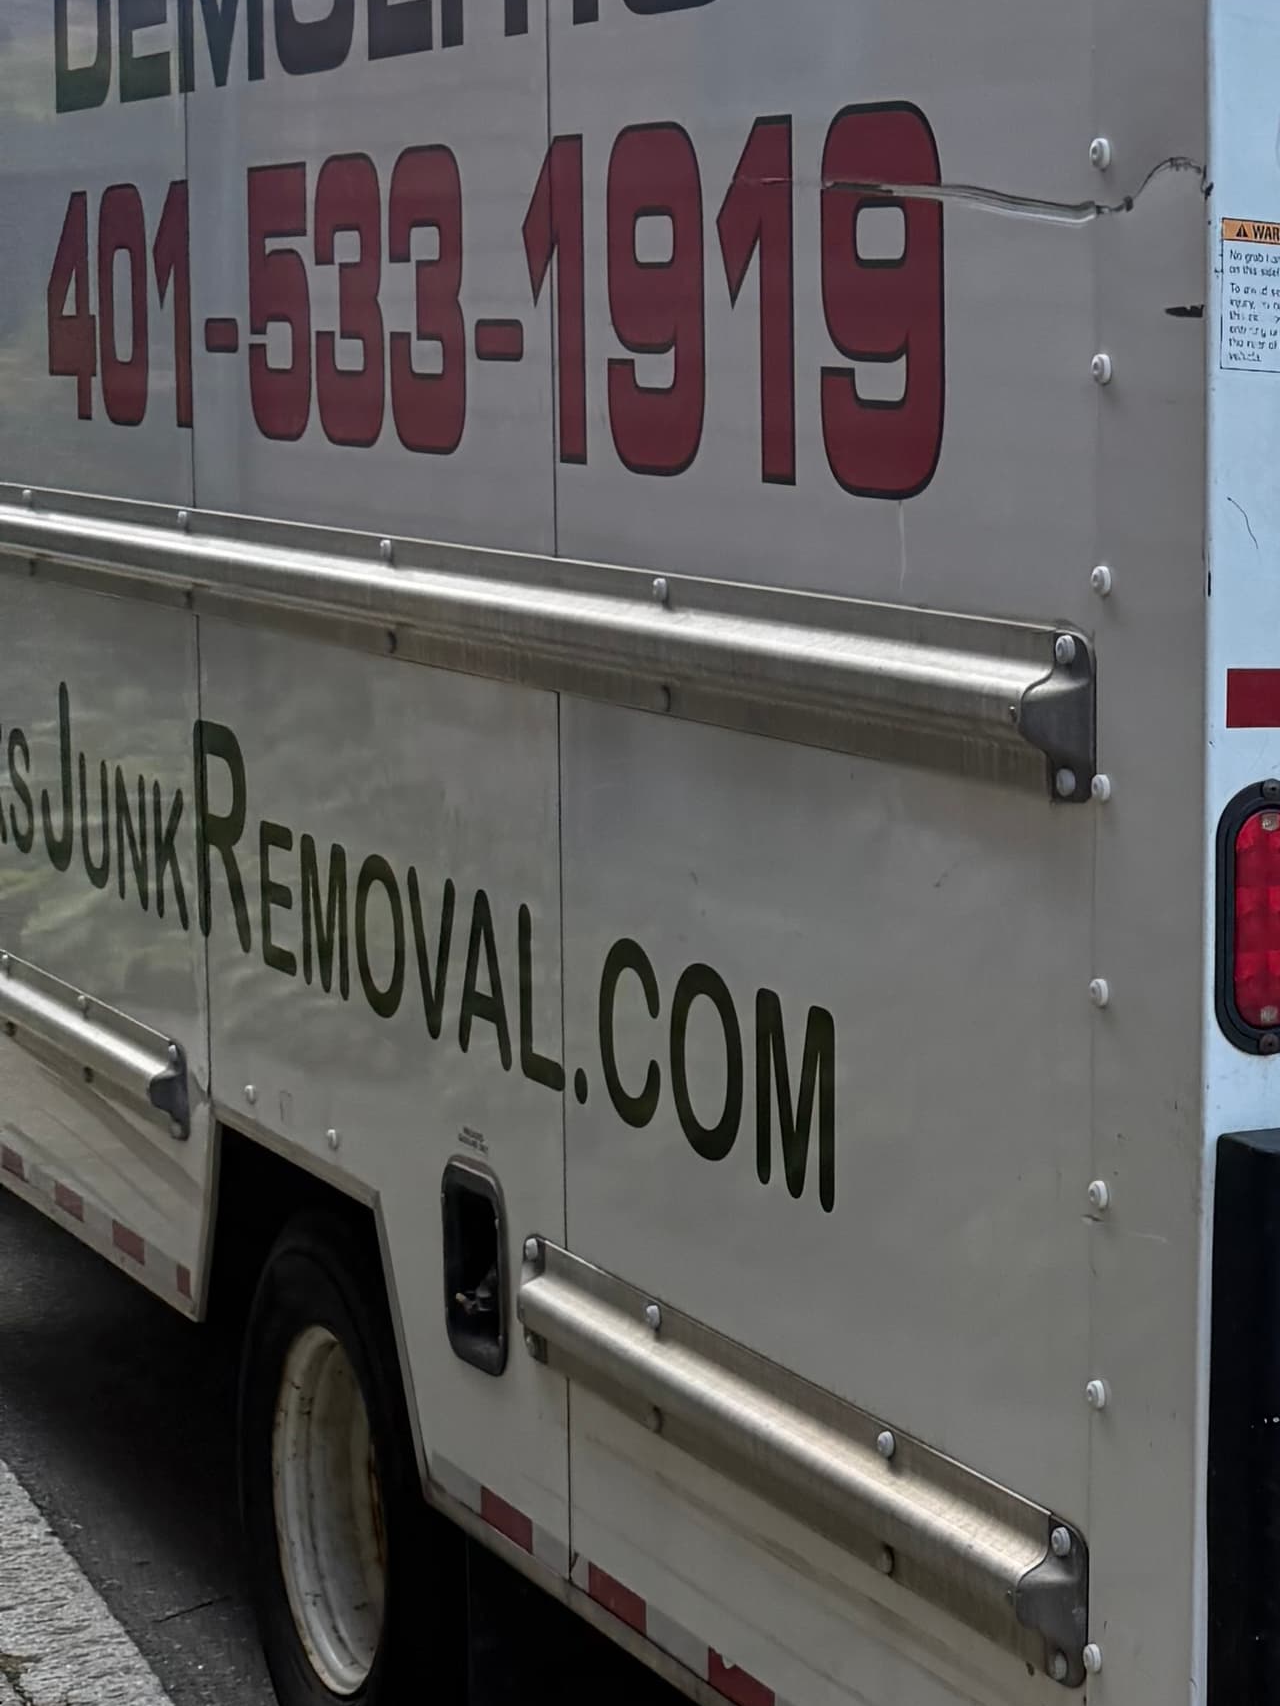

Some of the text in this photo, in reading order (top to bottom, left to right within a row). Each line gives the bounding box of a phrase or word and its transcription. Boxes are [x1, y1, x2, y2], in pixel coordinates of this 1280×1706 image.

[1229, 249, 1243, 260] No
[1230, 282, 1241, 294] To
[47, 100, 945, 500] 401-533-1919
